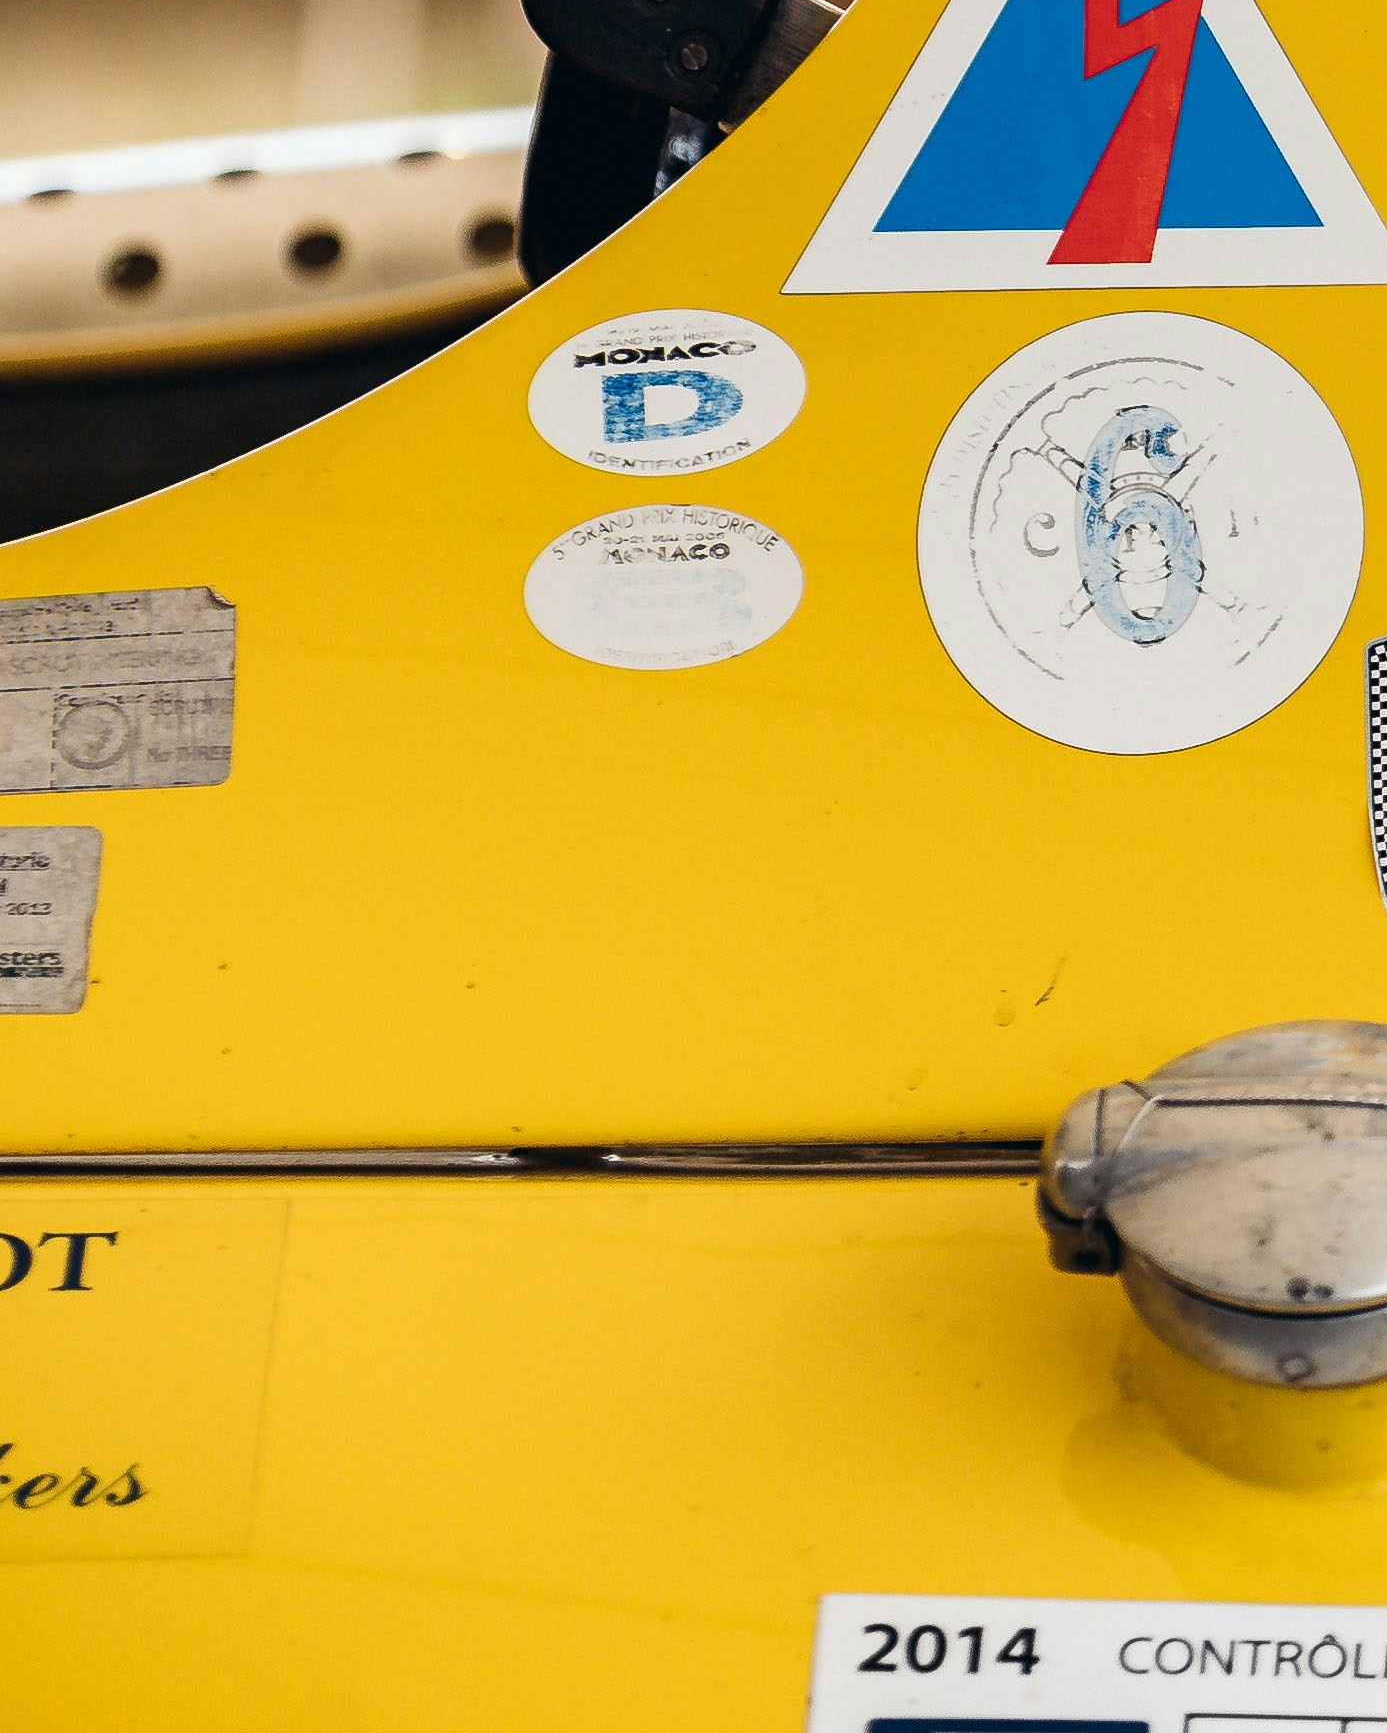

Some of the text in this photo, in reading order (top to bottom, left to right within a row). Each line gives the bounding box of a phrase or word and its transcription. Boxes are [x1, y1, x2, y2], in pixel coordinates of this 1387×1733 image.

[572, 339, 757, 369] MONACO
[601, 370, 744, 445] D
[588, 437, 752, 472] IDENTIFICATION
[571, 513, 635, 546] GRAND
[682, 508, 781, 552] HISTORIQUE
[1074, 404, 1206, 647] 6
[601, 542, 731, 565] MONACO
[855, 1623, 1042, 1676] 2014
